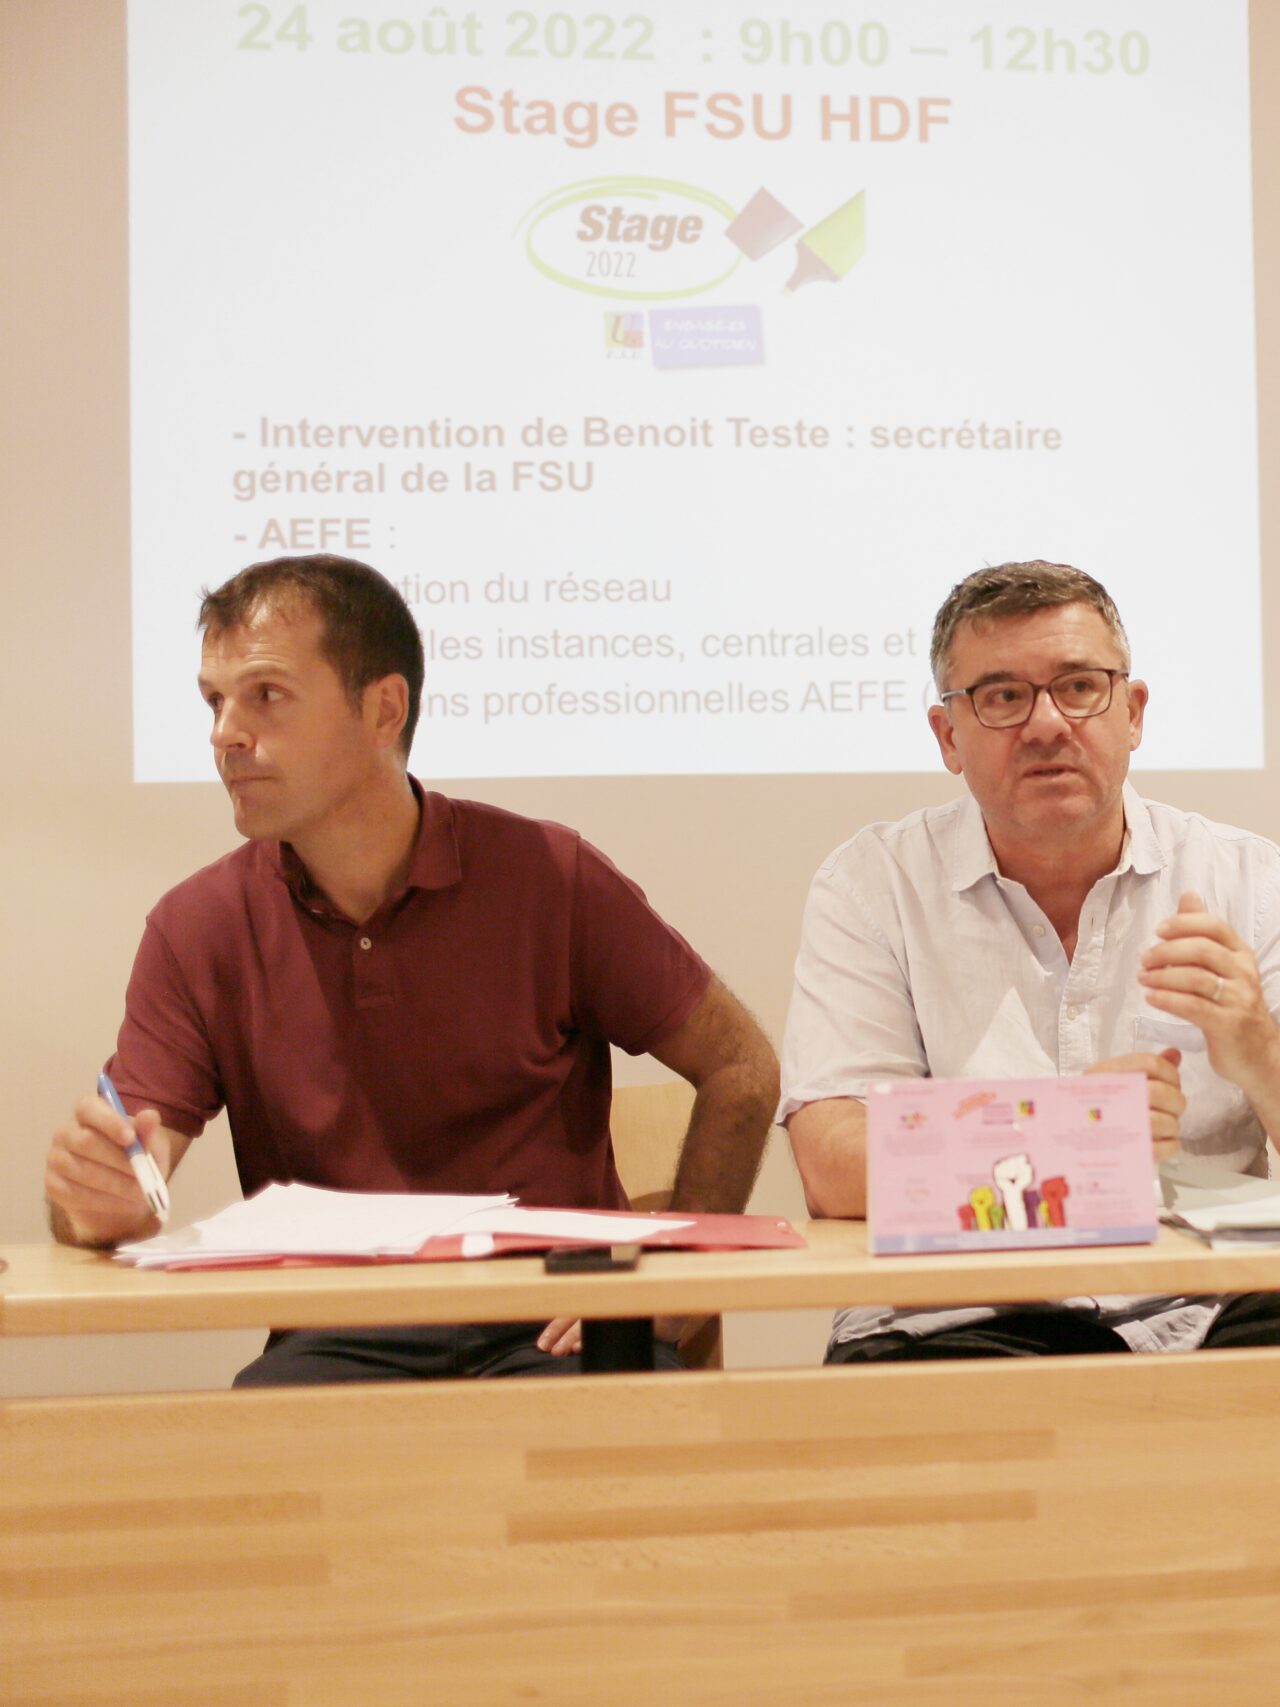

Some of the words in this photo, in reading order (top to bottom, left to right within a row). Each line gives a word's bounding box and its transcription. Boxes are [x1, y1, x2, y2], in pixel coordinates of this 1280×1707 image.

[237, 3, 313, 52] 24
[337, 7, 483, 56] août
[505, 11, 654, 60] 2022
[701, 28, 712, 63] :
[739, 19, 889, 67] 9h00
[971, 26, 1150, 76] 12h30
[454, 85, 638, 149] Stage
[664, 91, 792, 140] FSU
[820, 95, 951, 143] HDF
[576, 204, 703, 252] Stage
[587, 251, 636, 278] 2022
[261, 416, 504, 448] Intervention
[521, 417, 568, 447] de
[584, 417, 712, 447] Benoit
[726, 417, 829, 448] Teste
[846, 425, 854, 448] :
[871, 419, 1062, 450] secrétaire
[233, 462, 385, 502] général
[401, 462, 448, 493] de
[465, 462, 496, 492] la
[513, 461, 594, 492] FSU
[258, 518, 371, 549] AEFE
[402, 573, 470, 605] tion
[484, 572, 528, 603] du
[545, 571, 672, 602] réseau
[430, 629, 483, 660] les
[498, 628, 684, 662] instances,
[701, 626, 869, 658] centrales
[883, 627, 916, 656] et
[484, 681, 790, 725] professionnelles
[802, 681, 906, 712] AEFE
